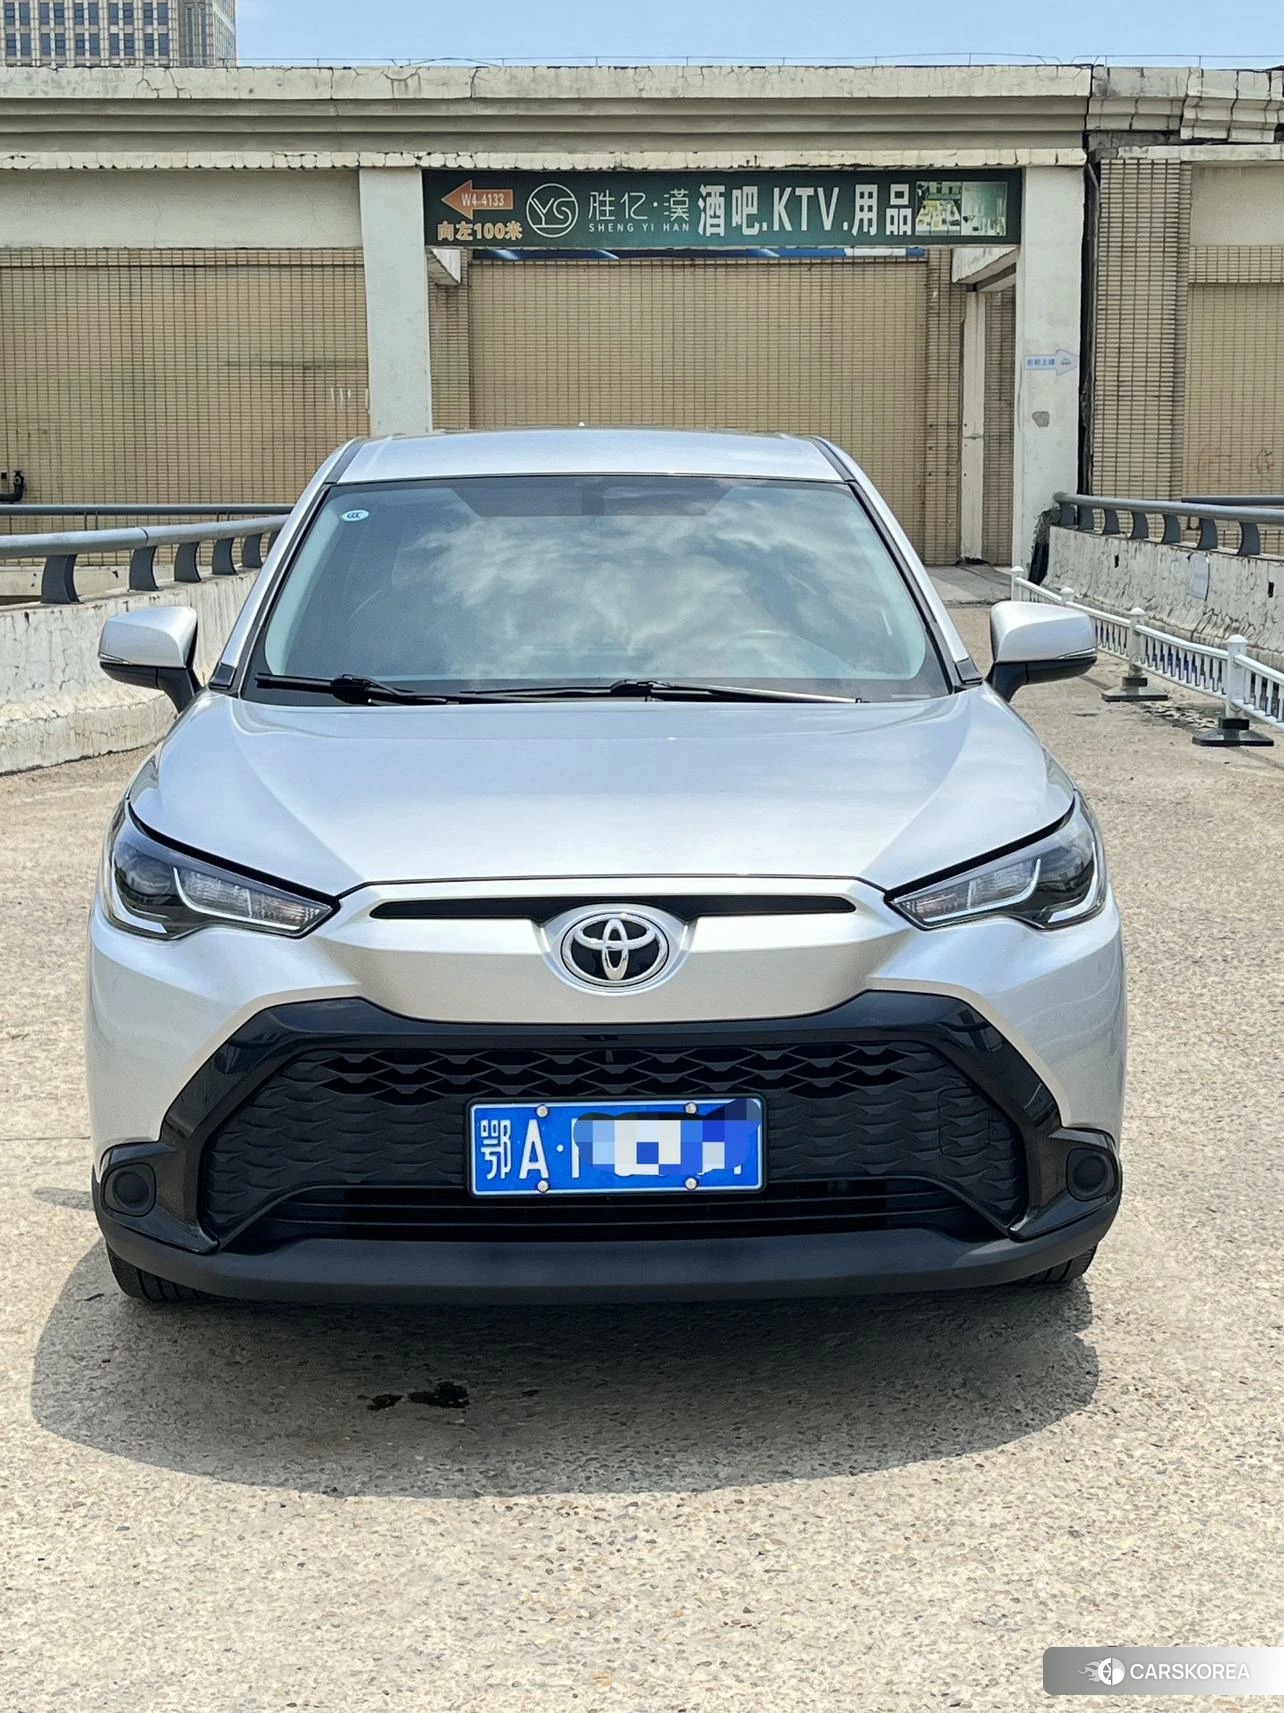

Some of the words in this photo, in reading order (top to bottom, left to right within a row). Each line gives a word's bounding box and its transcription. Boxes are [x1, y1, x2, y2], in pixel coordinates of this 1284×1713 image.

[461, 193, 505, 207] W4-4133
[437, 221, 523, 241] 向左100米
[588, 223, 634, 232] SHENG
[642, 223, 655, 232] YI
[663, 223, 690, 232] HAN
